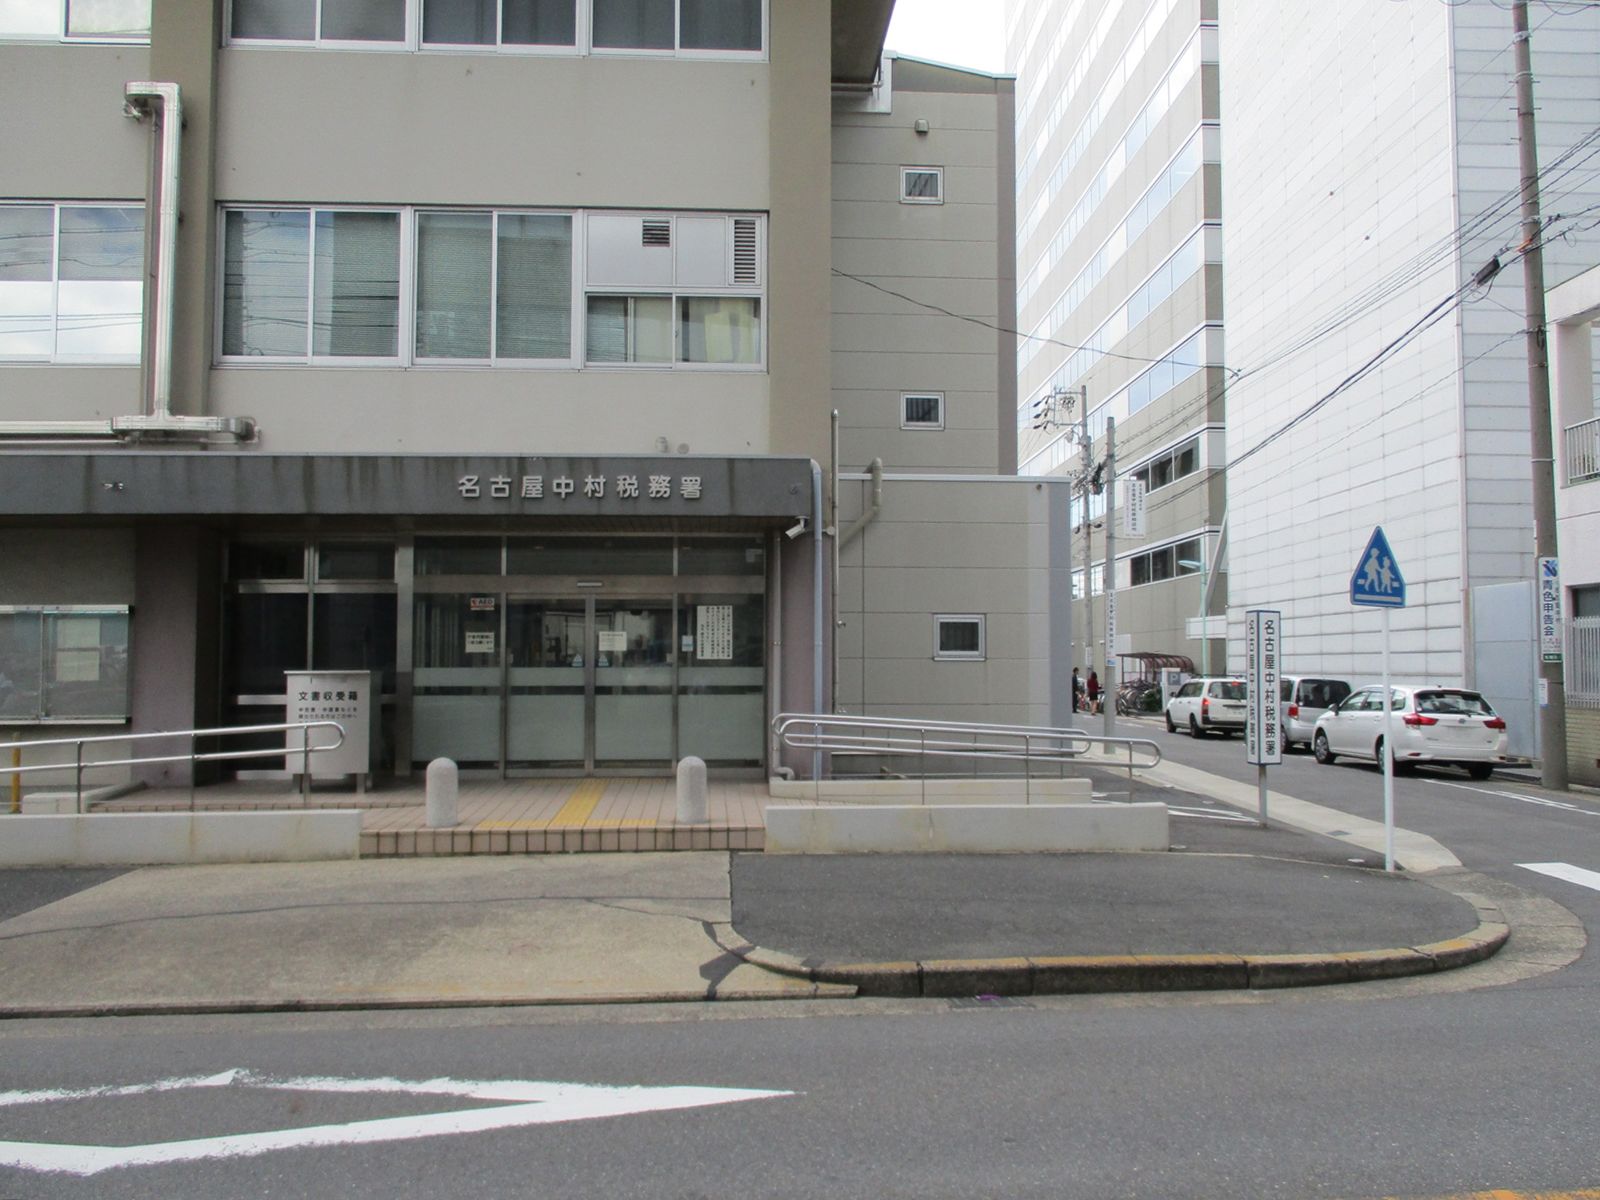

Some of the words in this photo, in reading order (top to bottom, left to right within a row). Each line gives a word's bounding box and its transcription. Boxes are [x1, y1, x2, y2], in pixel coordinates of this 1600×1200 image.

[457, 474, 703, 499] 名古屋中村税務署
[1543, 580, 1555, 636] 青色申告会
[298, 691, 358, 701] 文書収受箱
[1264, 619, 1276, 756] 名古屋中村税務署
